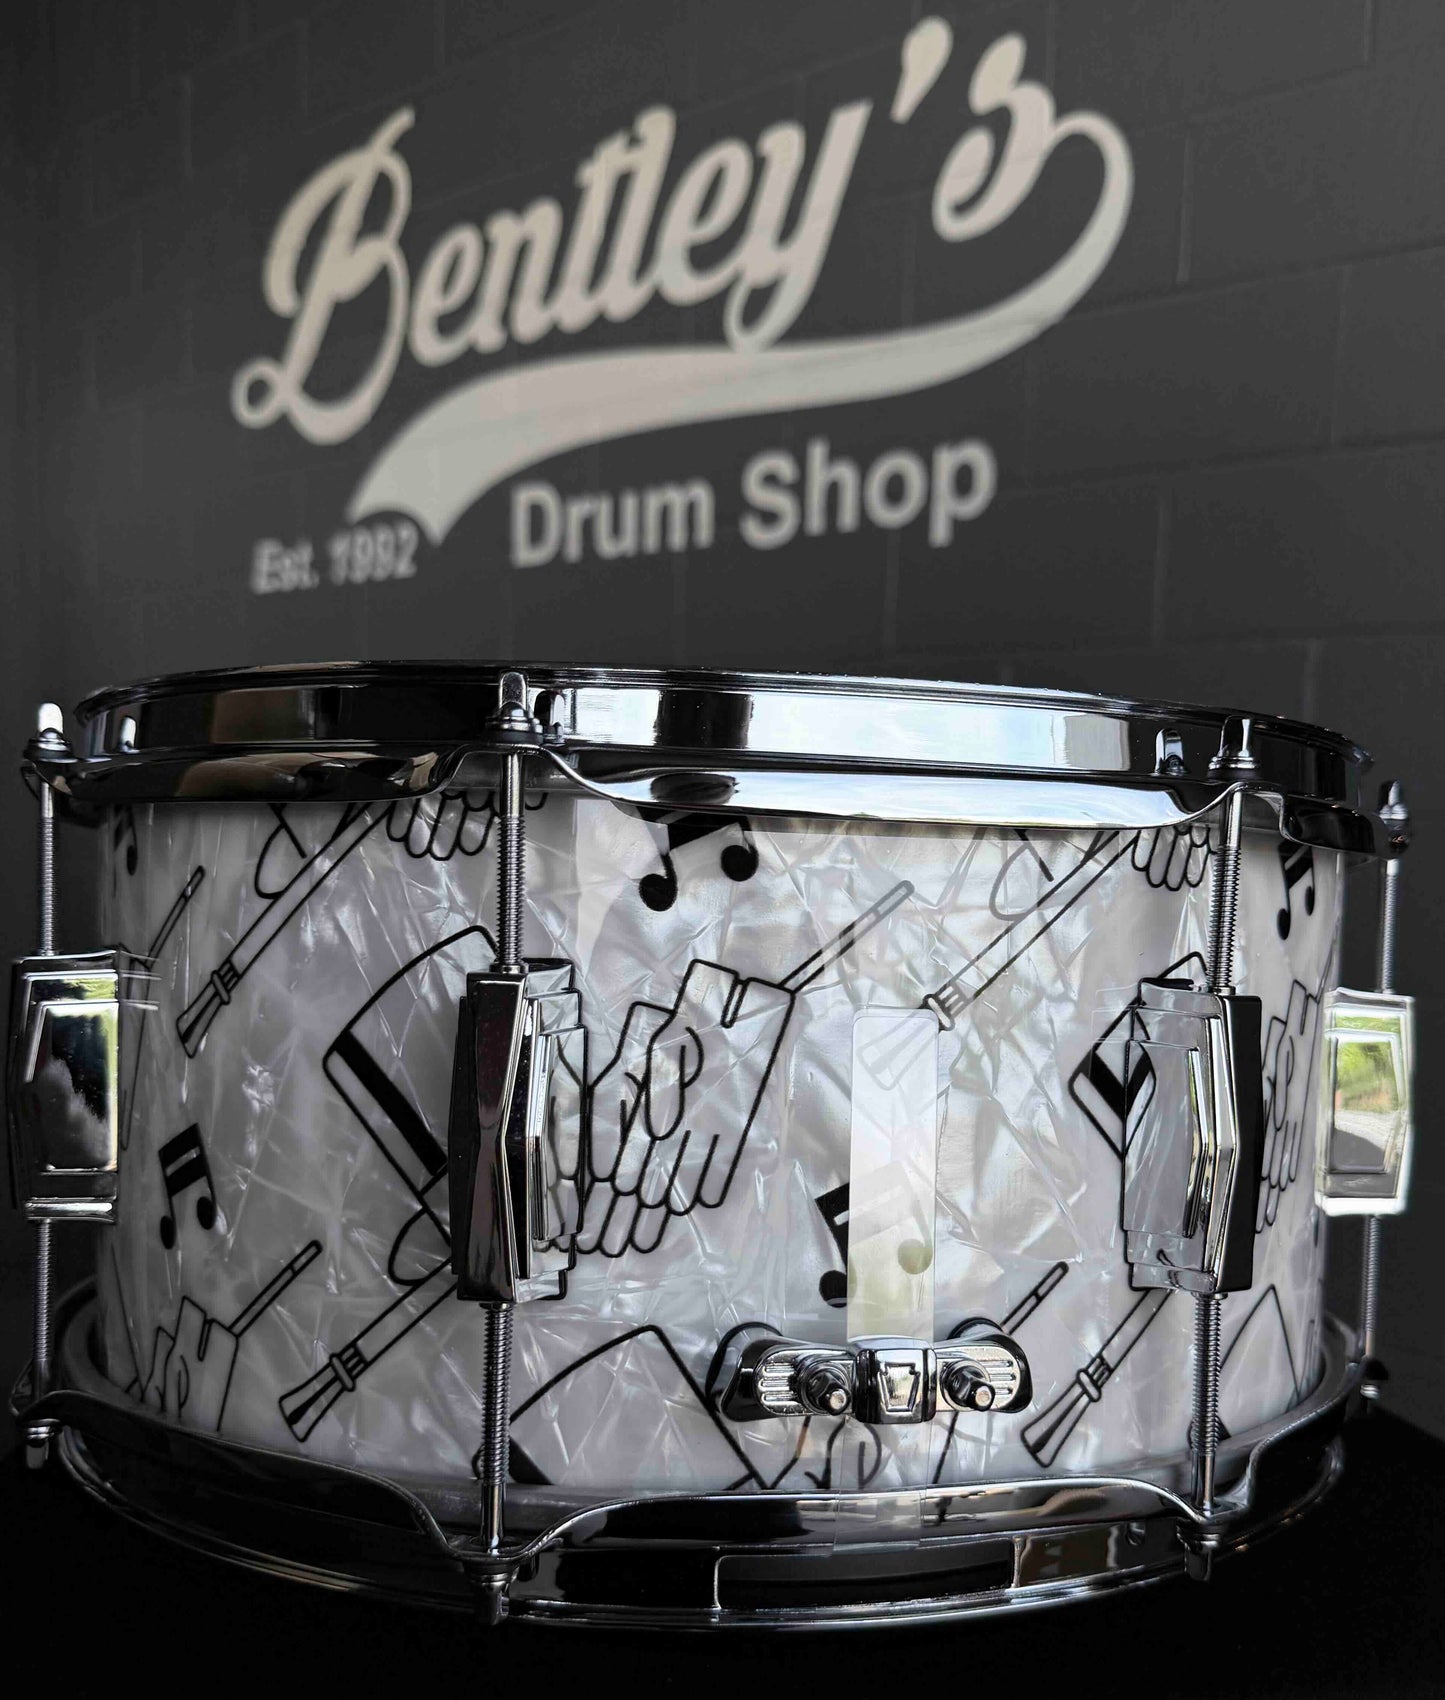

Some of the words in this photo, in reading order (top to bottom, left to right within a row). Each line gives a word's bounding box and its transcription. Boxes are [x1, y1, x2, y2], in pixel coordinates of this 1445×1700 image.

[231, 16, 1060, 445] Bentley's
[251, 538, 320, 594] Est.
[327, 520, 419, 586] 1992
[510, 479, 715, 569] Drum
[740, 438, 997, 549] Shop
